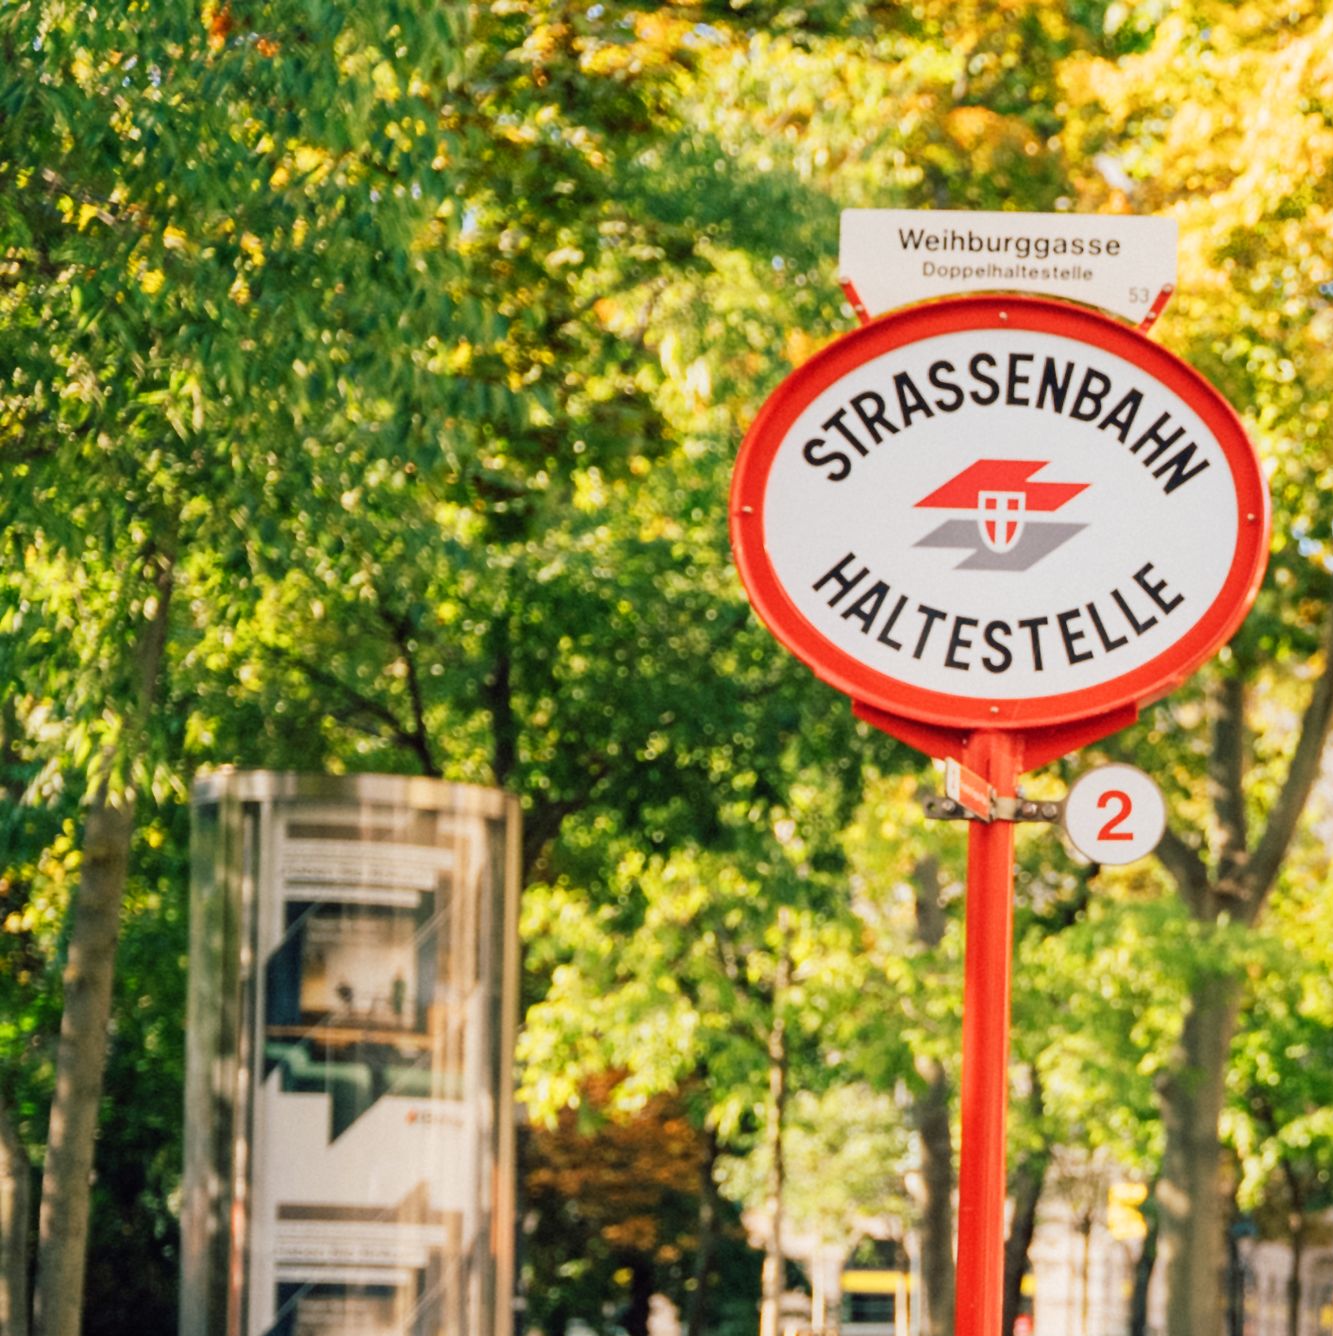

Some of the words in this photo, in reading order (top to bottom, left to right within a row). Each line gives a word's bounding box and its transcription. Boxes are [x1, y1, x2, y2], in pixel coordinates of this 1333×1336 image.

[899, 227, 1122, 259] Weihburggasse
[922, 261, 1094, 282] Doppelhaltestelle
[1128, 286, 1151, 304] 53
[802, 352, 1210, 495] STRASSENBAHN
[811, 552, 1185, 674] HALTESTELLE
[1096, 789, 1134, 841] 2
